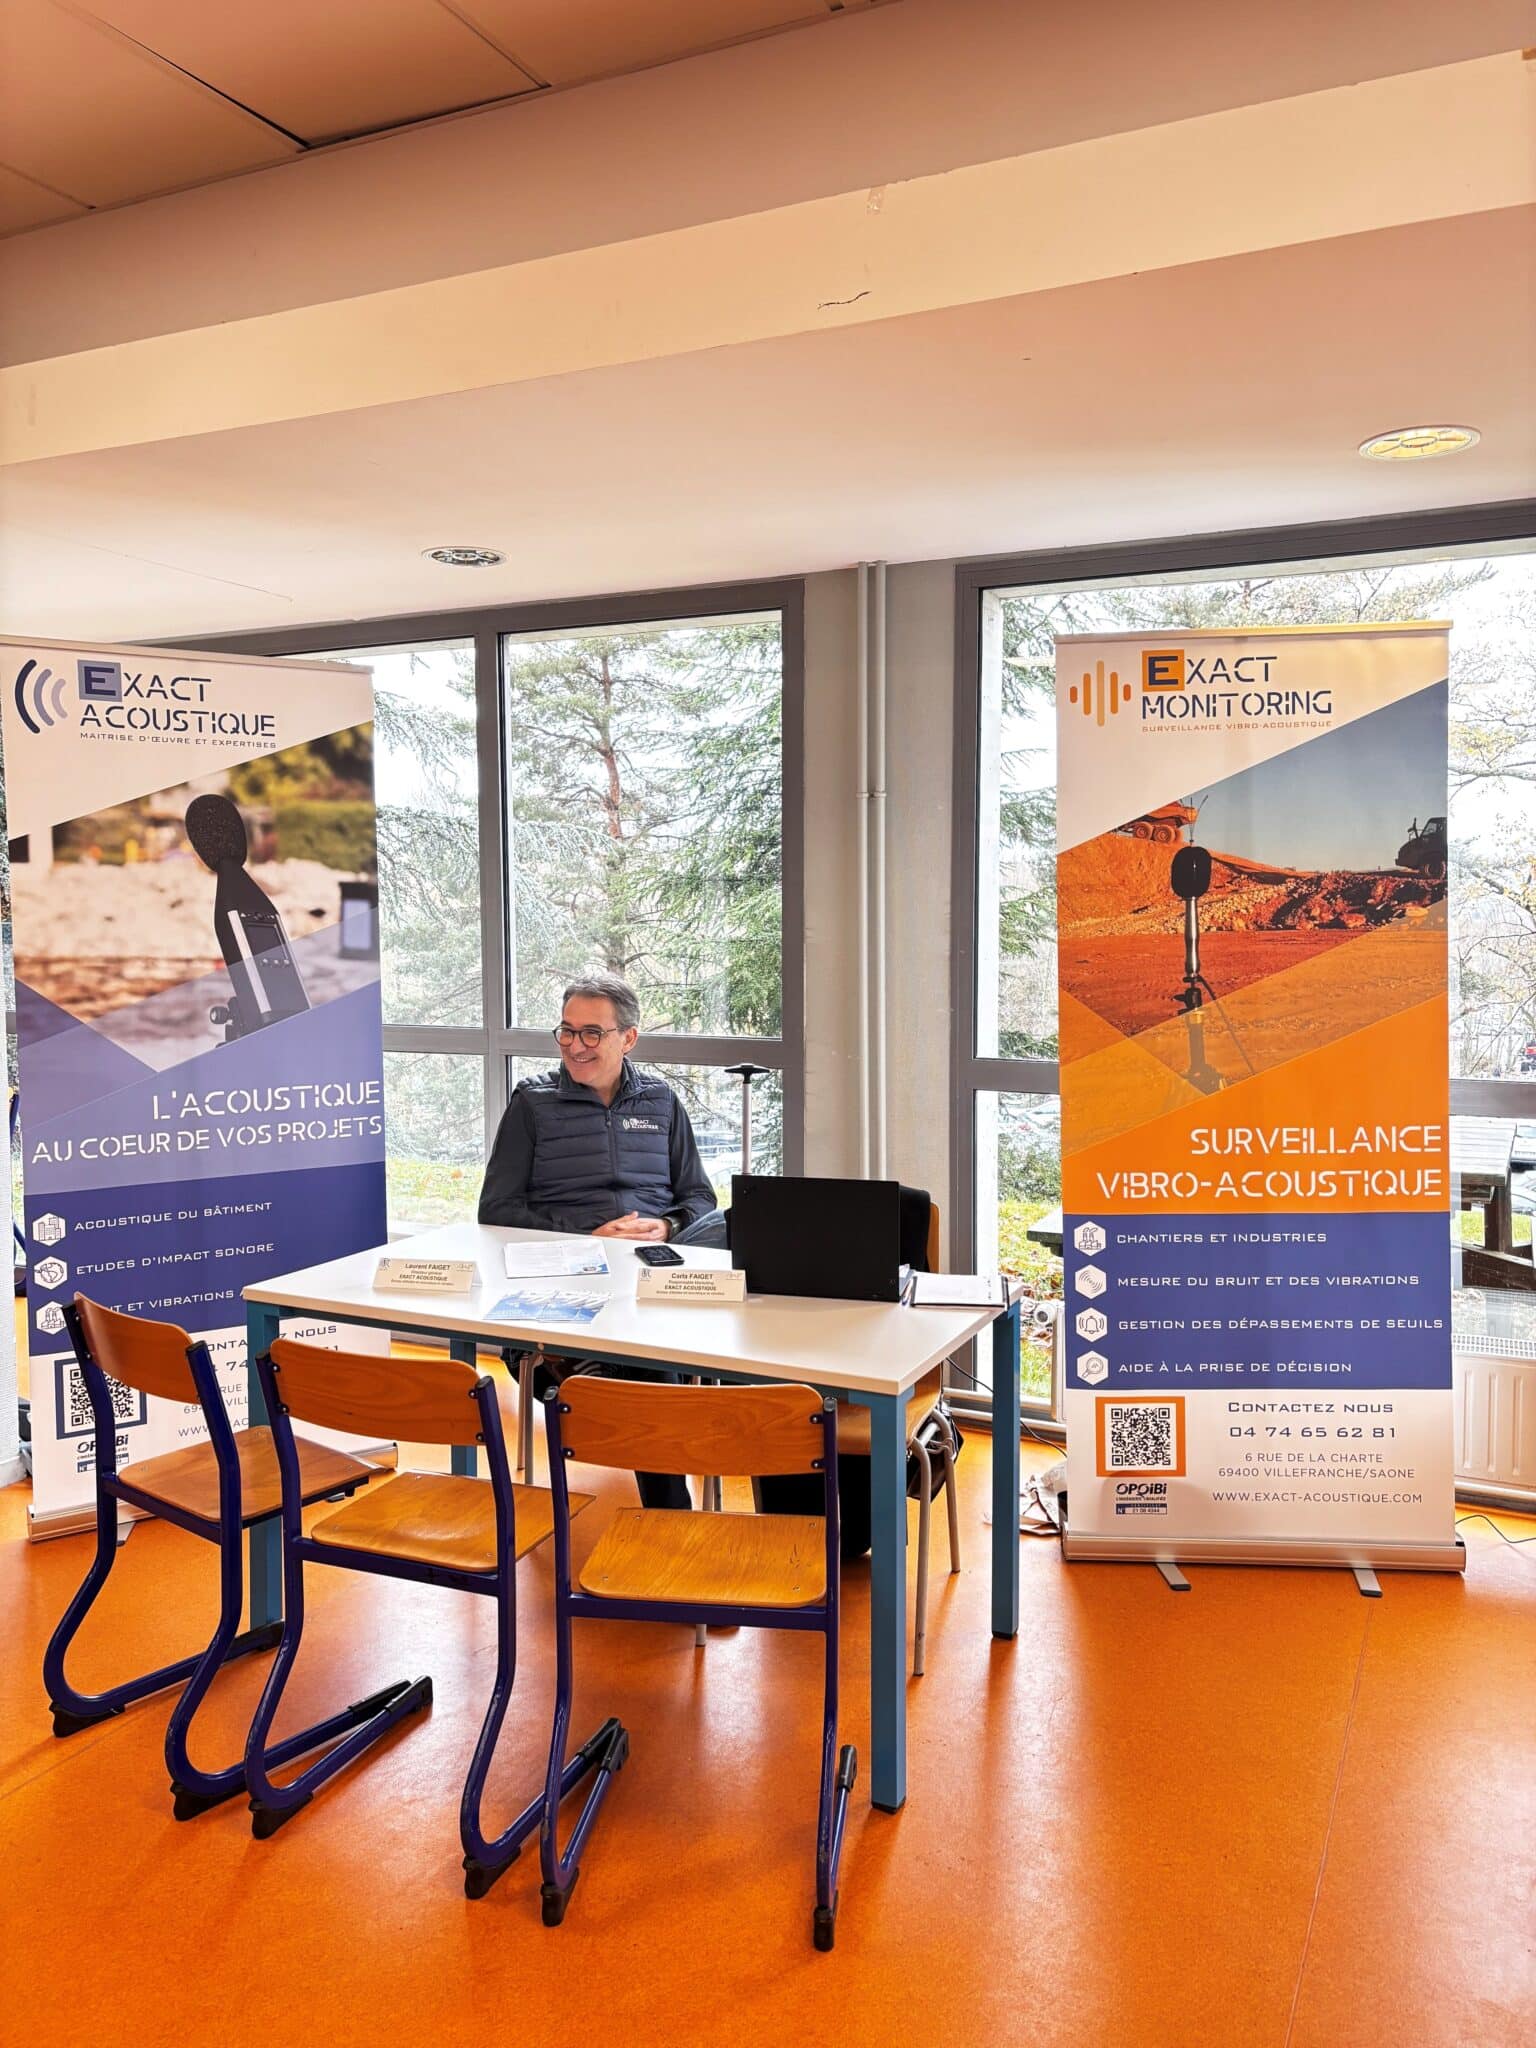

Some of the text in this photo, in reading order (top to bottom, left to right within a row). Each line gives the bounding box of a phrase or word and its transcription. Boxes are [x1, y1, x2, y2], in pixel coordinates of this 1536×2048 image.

[1148, 655, 1278, 686] EXACT
[84, 665, 212, 702] EXACT
[1142, 690, 1332, 720] MONITORING
[80, 704, 276, 737] ACOUSTIQUE
[1142, 724, 1222, 733] SURVEILLANCE
[80, 732, 133, 741] MAITRISE
[211, 739, 277, 749] EXPERTISES
[153, 1080, 381, 1120] L'ACOUSTIQUE
[32, 1115, 382, 1164] AU COEUR DE VOS PROJETS
[1190, 1126, 1442, 1155] SURVEILLANCE
[1096, 1169, 1442, 1199] VIBRO-ACOUSTIQUE
[74, 1201, 273, 1231] ACOUSTIQUE DU BÂTIMENT
[1116, 1232, 1328, 1244] CHANTIERS ET INDUSTRIES
[76, 1243, 275, 1275] ETUDES D'IMPACT SONORE
[1117, 1275, 1420, 1287] MESURE DU BRUIT ET DES VIBRATIONS
[128, 1301, 144, 1311] ET
[149, 1290, 234, 1309] VIBRATIONS
[1118, 1317, 1444, 1330] GESTION DES DÉPASSEMENTS DE SEUILS
[295, 1325, 337, 1339] NOUS
[1118, 1360, 1352, 1373] AIDE À LA PRISE DE DÉCISION
[220, 1383, 242, 1394] RUE
[1228, 1402, 1394, 1413] CONTACTEZ NOUS
[1230, 1427, 1396, 1438] 04 74 65 62 81
[1245, 1453, 1383, 1463] 6 RUE DE LA CHARTE
[1218, 1467, 1415, 1479] 69400 VILLEFRANCHE/SAONE
[1212, 1491, 1423, 1503] WWW.EXACT-ACOUSTIQUE.COM
